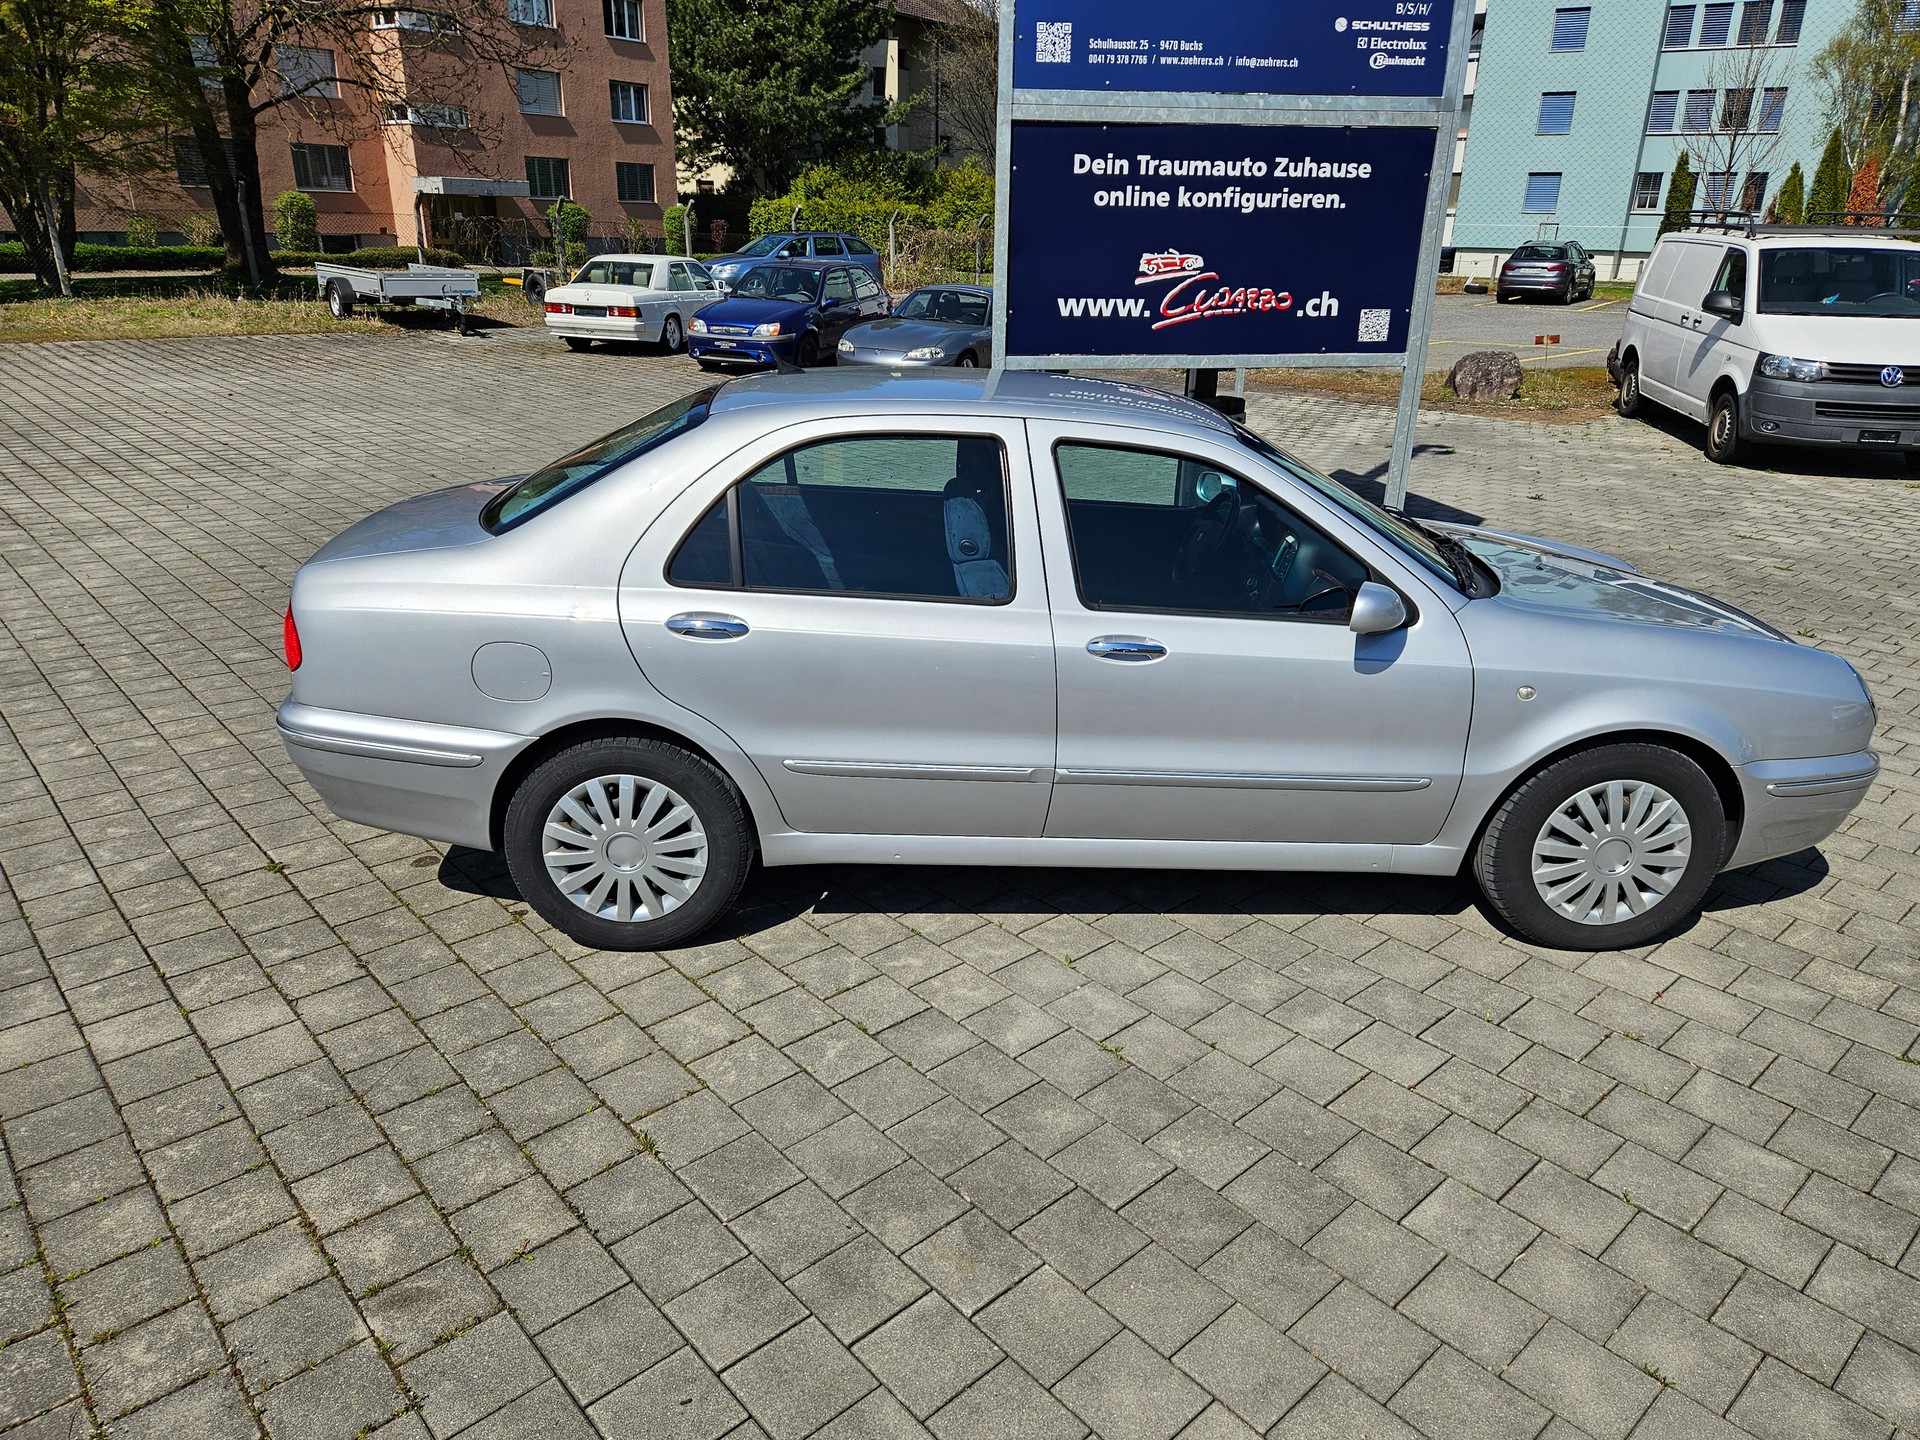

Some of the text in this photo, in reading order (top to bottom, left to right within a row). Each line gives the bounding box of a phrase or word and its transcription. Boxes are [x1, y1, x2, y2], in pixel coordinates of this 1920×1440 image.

[1395, 2, 1433, 16] B/S/H/
[1351, 20, 1431, 32] SCHULTHESS
[1088, 38, 1139, 50] Schulhausstr.
[1139, 39, 1149, 50] 25
[1159, 39, 1179, 51] 9470
[1180, 40, 1203, 51] Buchs
[1369, 37, 1428, 51] Electrolux
[1088, 53, 1105, 64] 0041
[1106, 54, 1115, 64] 79
[1116, 54, 1130, 65] 378
[1130, 54, 1148, 65] 7766
[1159, 54, 1224, 66] www.zoehrers.ch
[1235, 55, 1299, 69] info@zoehrers.ch
[1369, 51, 1426, 69] Bauknecht
[1073, 152, 1372, 179] Dein Traumauto Zuhause
[1093, 185, 1346, 214] online konfigurieren.
